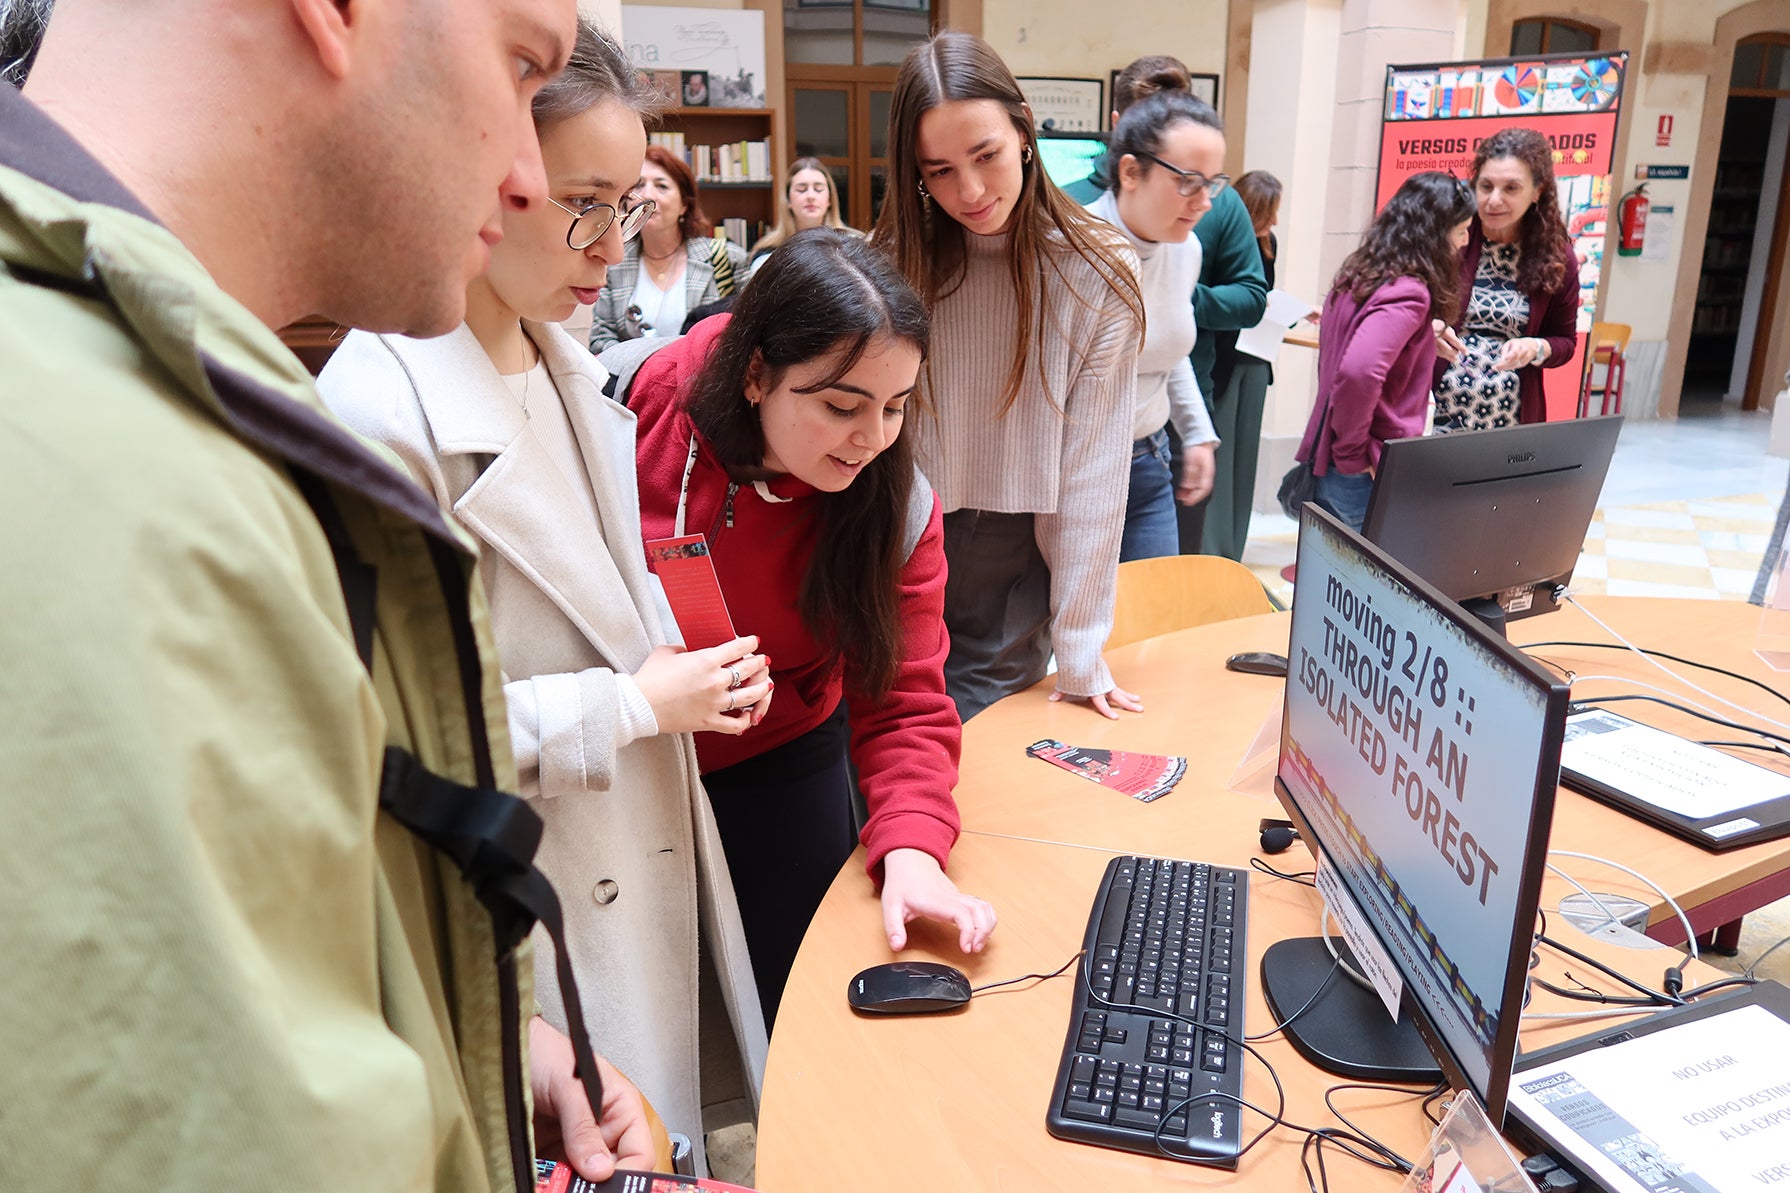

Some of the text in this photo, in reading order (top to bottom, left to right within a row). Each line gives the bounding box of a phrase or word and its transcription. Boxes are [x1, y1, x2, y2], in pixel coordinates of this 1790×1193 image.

[1398, 138, 1467, 155] VERSOS
[1507, 452, 1536, 464] PHILIPS
[1326, 574, 1396, 671] moving
[1402, 630, 1448, 708] 2/8
[1323, 616, 1468, 803] THROUGH AN
[1299, 646, 1499, 907] ISOLATED FOREST
[1672, 1055, 1739, 1081] NO USAR
[1682, 1081, 1790, 1126] EQUIPO DESTIN
[1210, 1110, 1225, 1139] logitech
[1719, 1106, 1790, 1141] A LA EXPO
